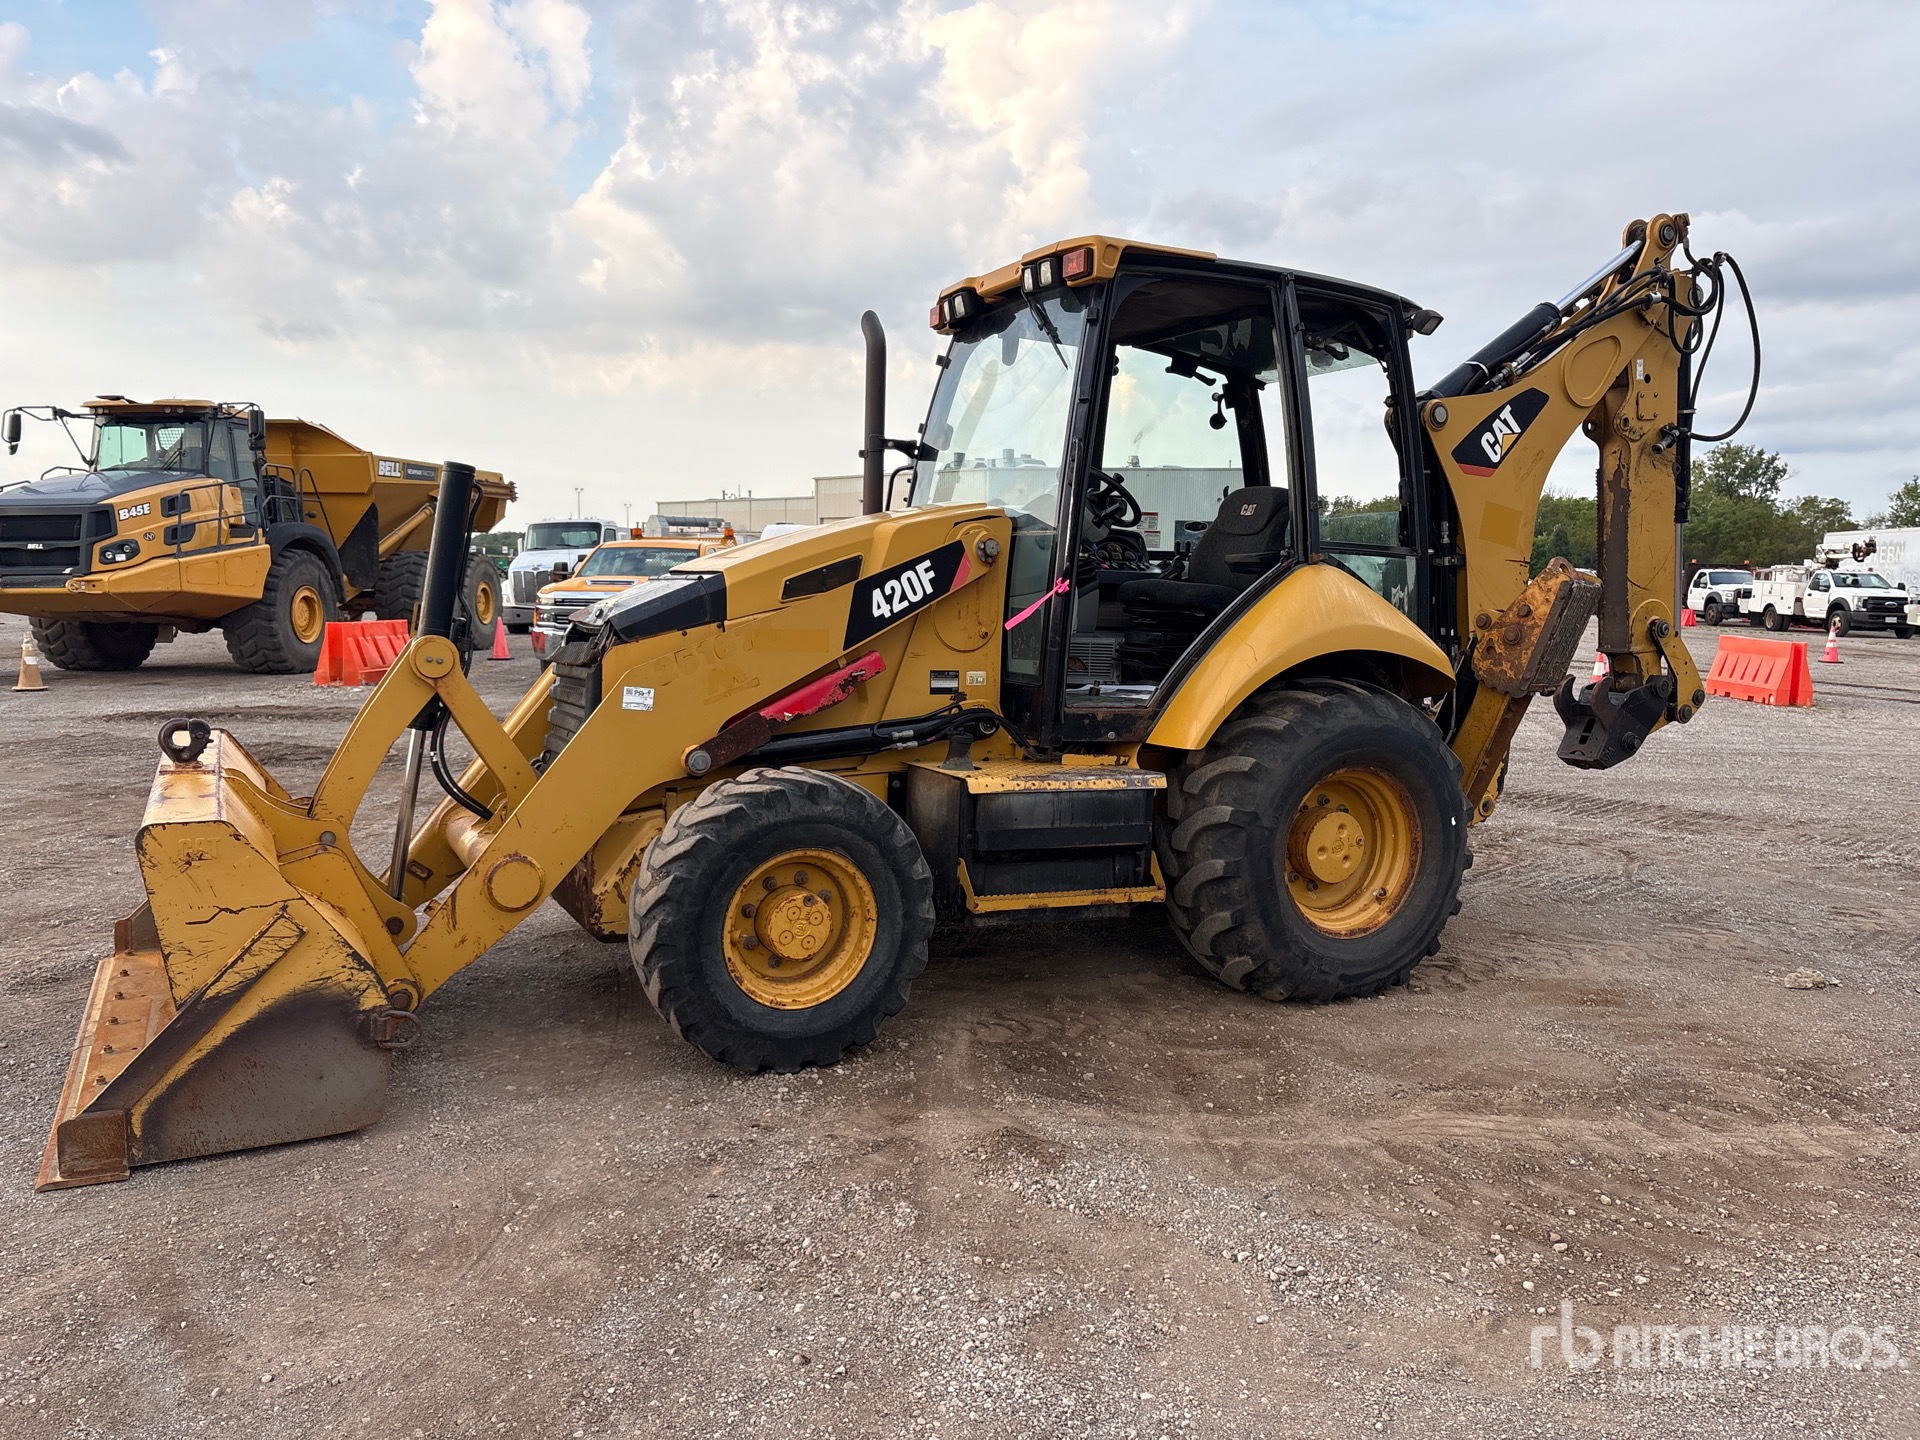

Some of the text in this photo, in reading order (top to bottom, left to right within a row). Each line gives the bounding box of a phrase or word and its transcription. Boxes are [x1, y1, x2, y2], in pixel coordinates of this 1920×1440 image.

[1481, 404, 1521, 463] CAT
[378, 460, 401, 478] BELL
[118, 503, 151, 521] B45E
[1240, 504, 1257, 516] CAT
[872, 559, 936, 619] 420F
